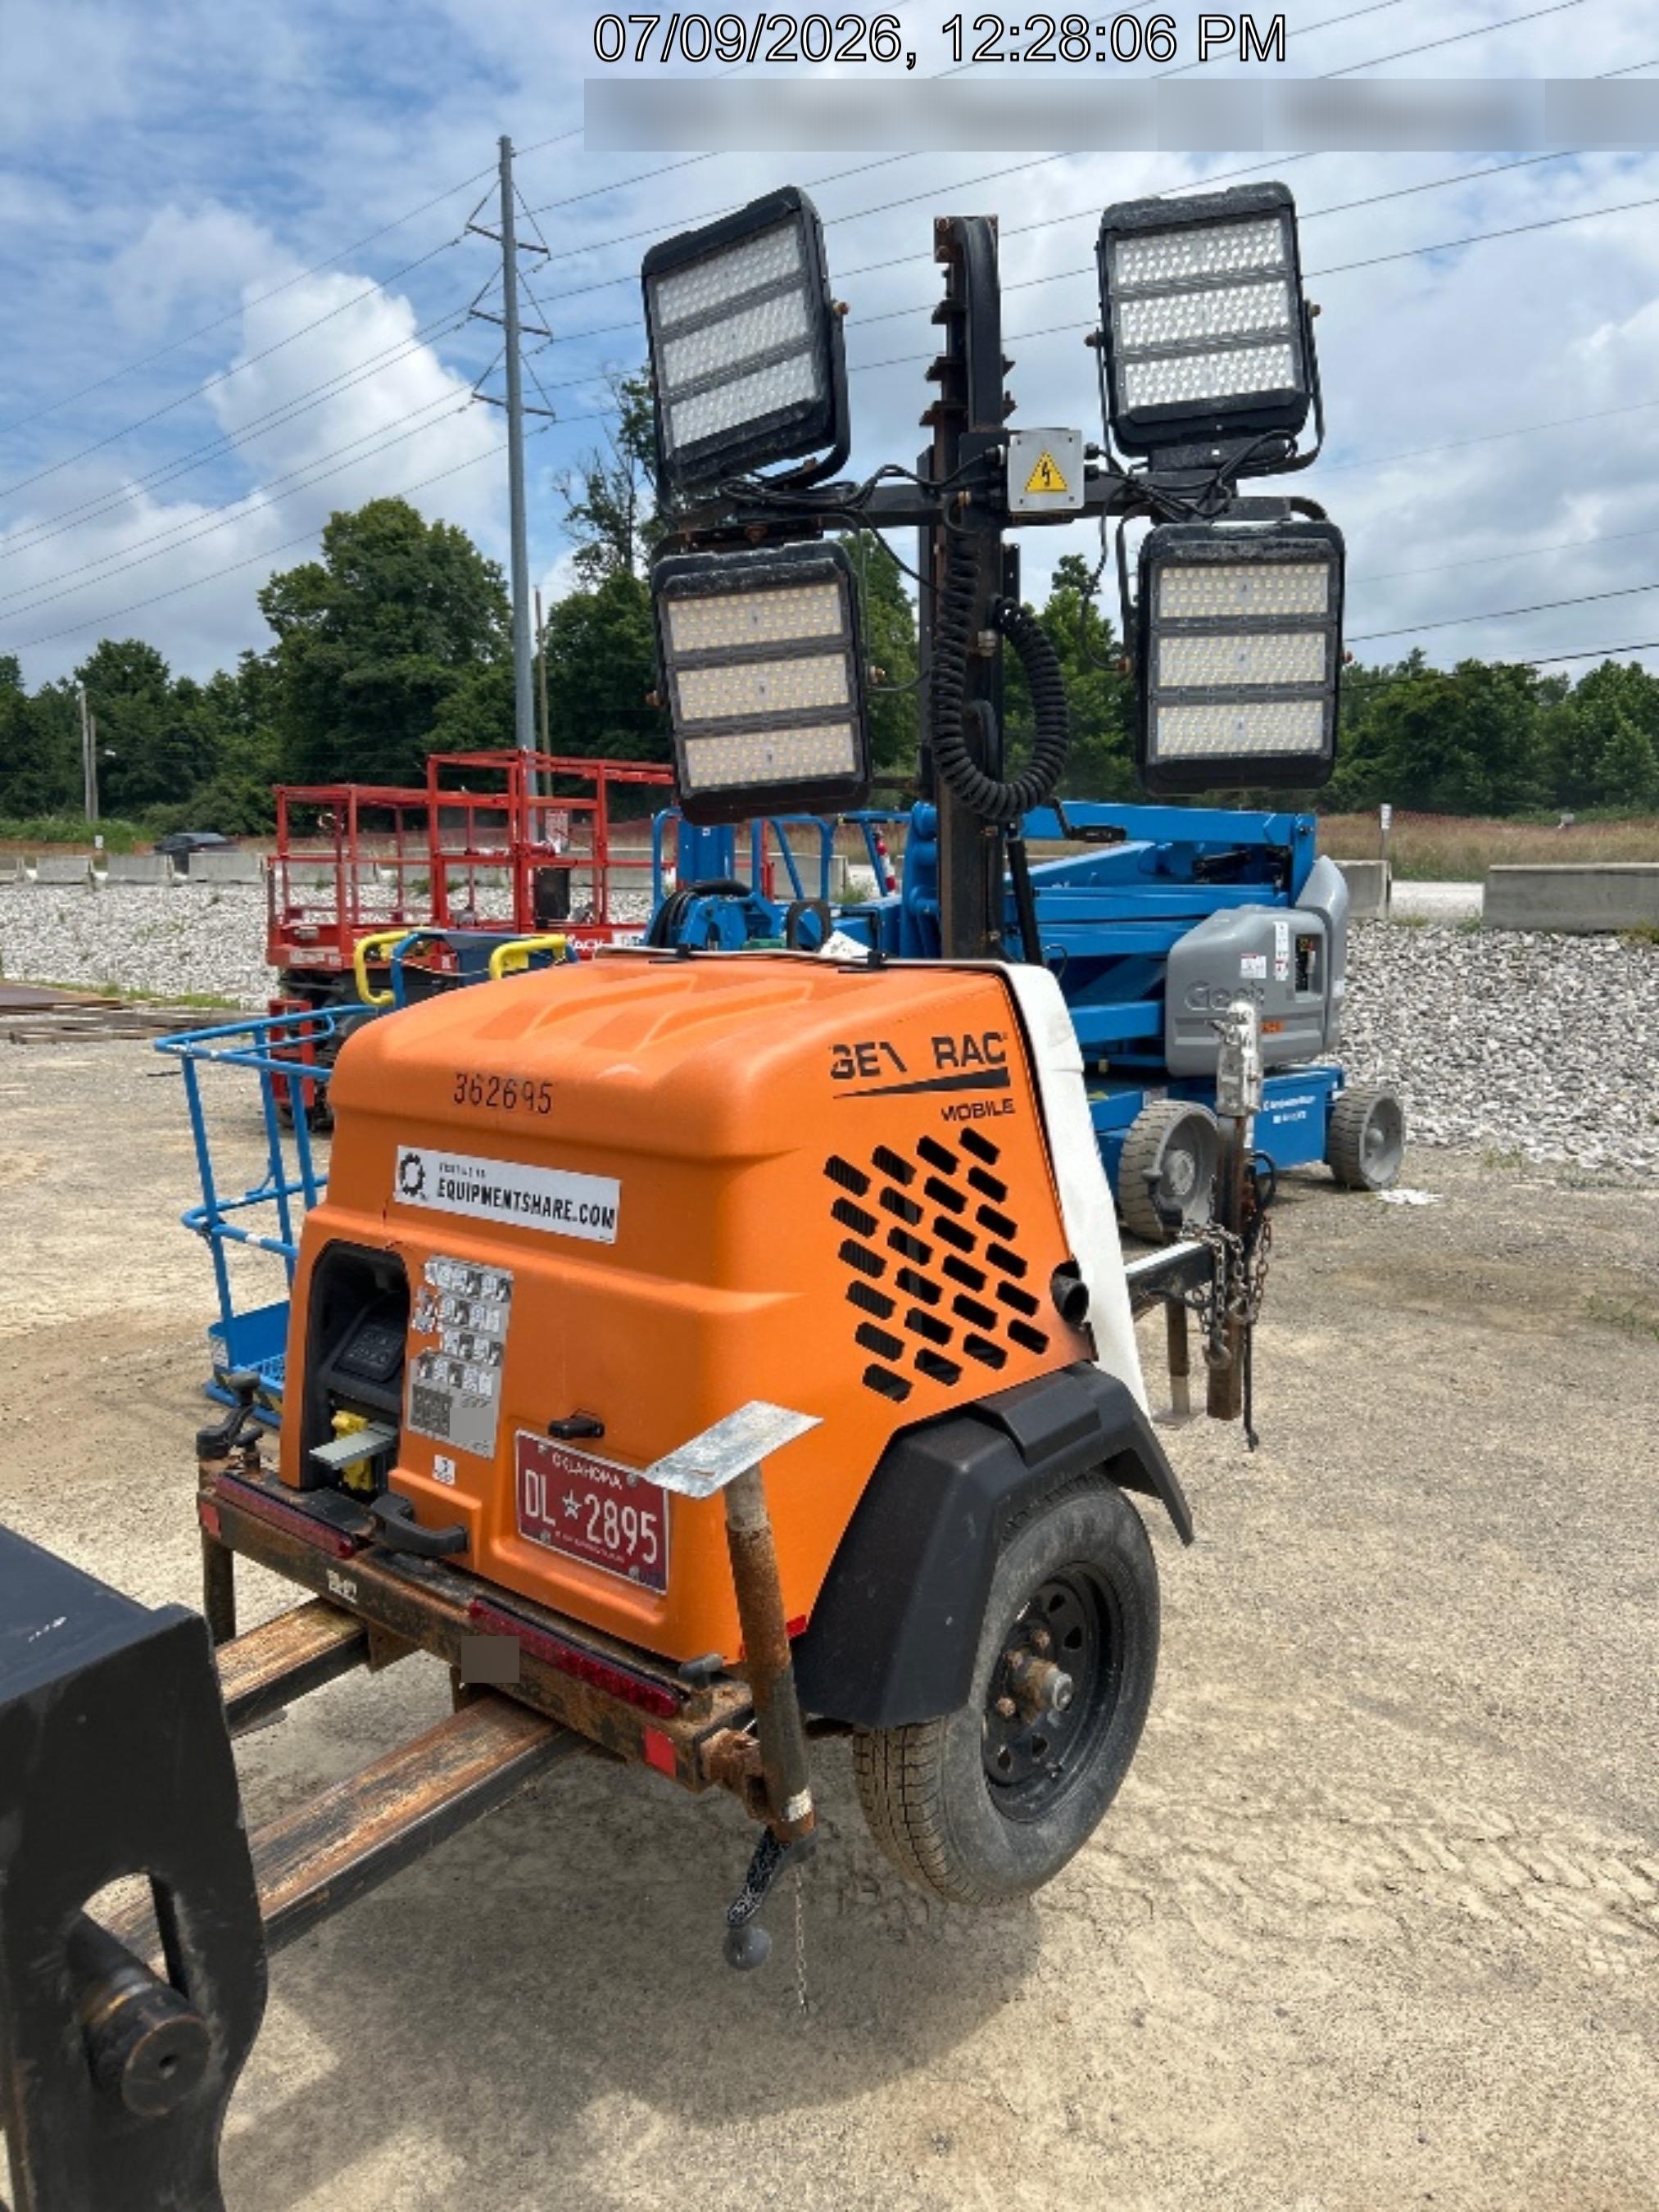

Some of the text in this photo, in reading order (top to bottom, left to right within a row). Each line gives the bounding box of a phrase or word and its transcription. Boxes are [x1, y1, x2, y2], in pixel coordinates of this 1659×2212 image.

[829, 1031, 1007, 1080] GERAC
[453, 1072, 553, 1114] 362695
[941, 1098, 1016, 1122] MOBILE
[437, 1178, 615, 1229] EQUIPMENTSHARE.COM
[524, 1469, 556, 1527] DL
[583, 1493, 657, 1564] 2895
